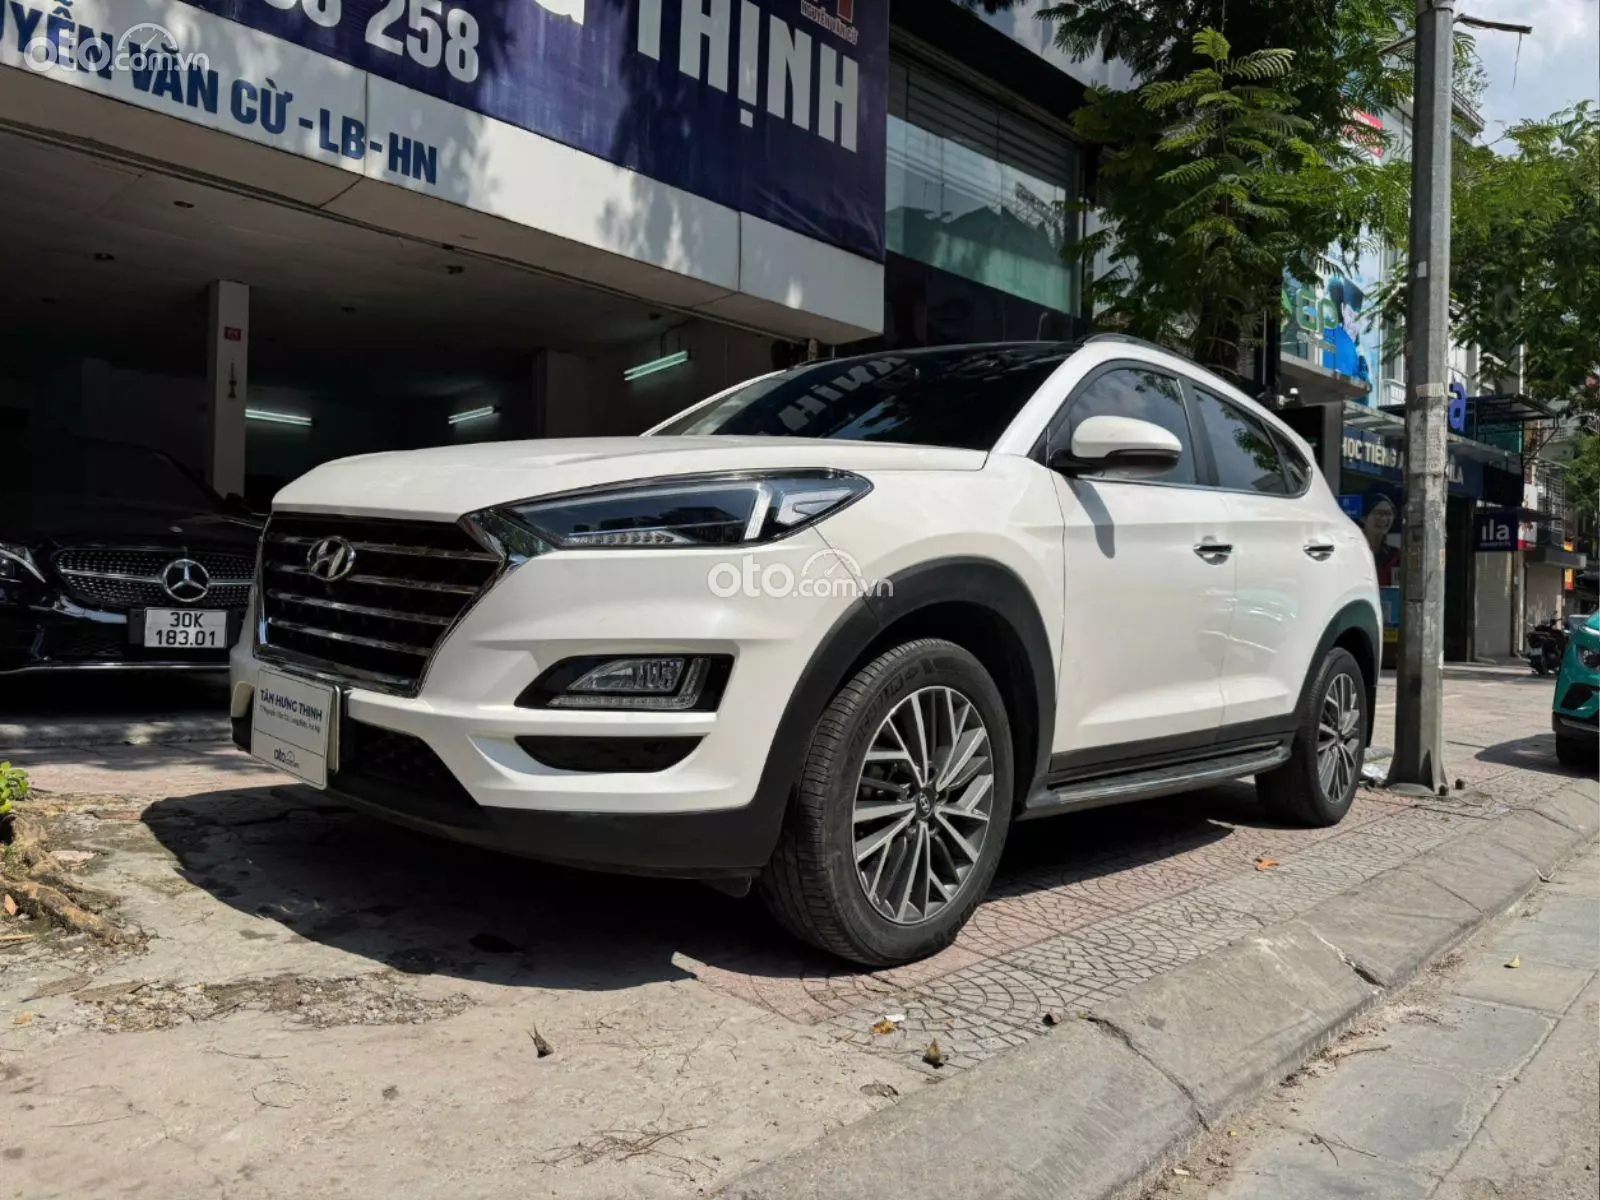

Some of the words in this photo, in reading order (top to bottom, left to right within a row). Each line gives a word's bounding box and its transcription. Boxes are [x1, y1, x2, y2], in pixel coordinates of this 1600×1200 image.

[364, 0, 480, 84] 258
[0, 0, 115, 81] YỄN
[127, 41, 220, 114] VĂN
[229, 77, 294, 135] CỪ
[1481, 518, 1510, 541] ila
[169, 611, 204, 628] 30K
[156, 630, 216, 646] 183.01
